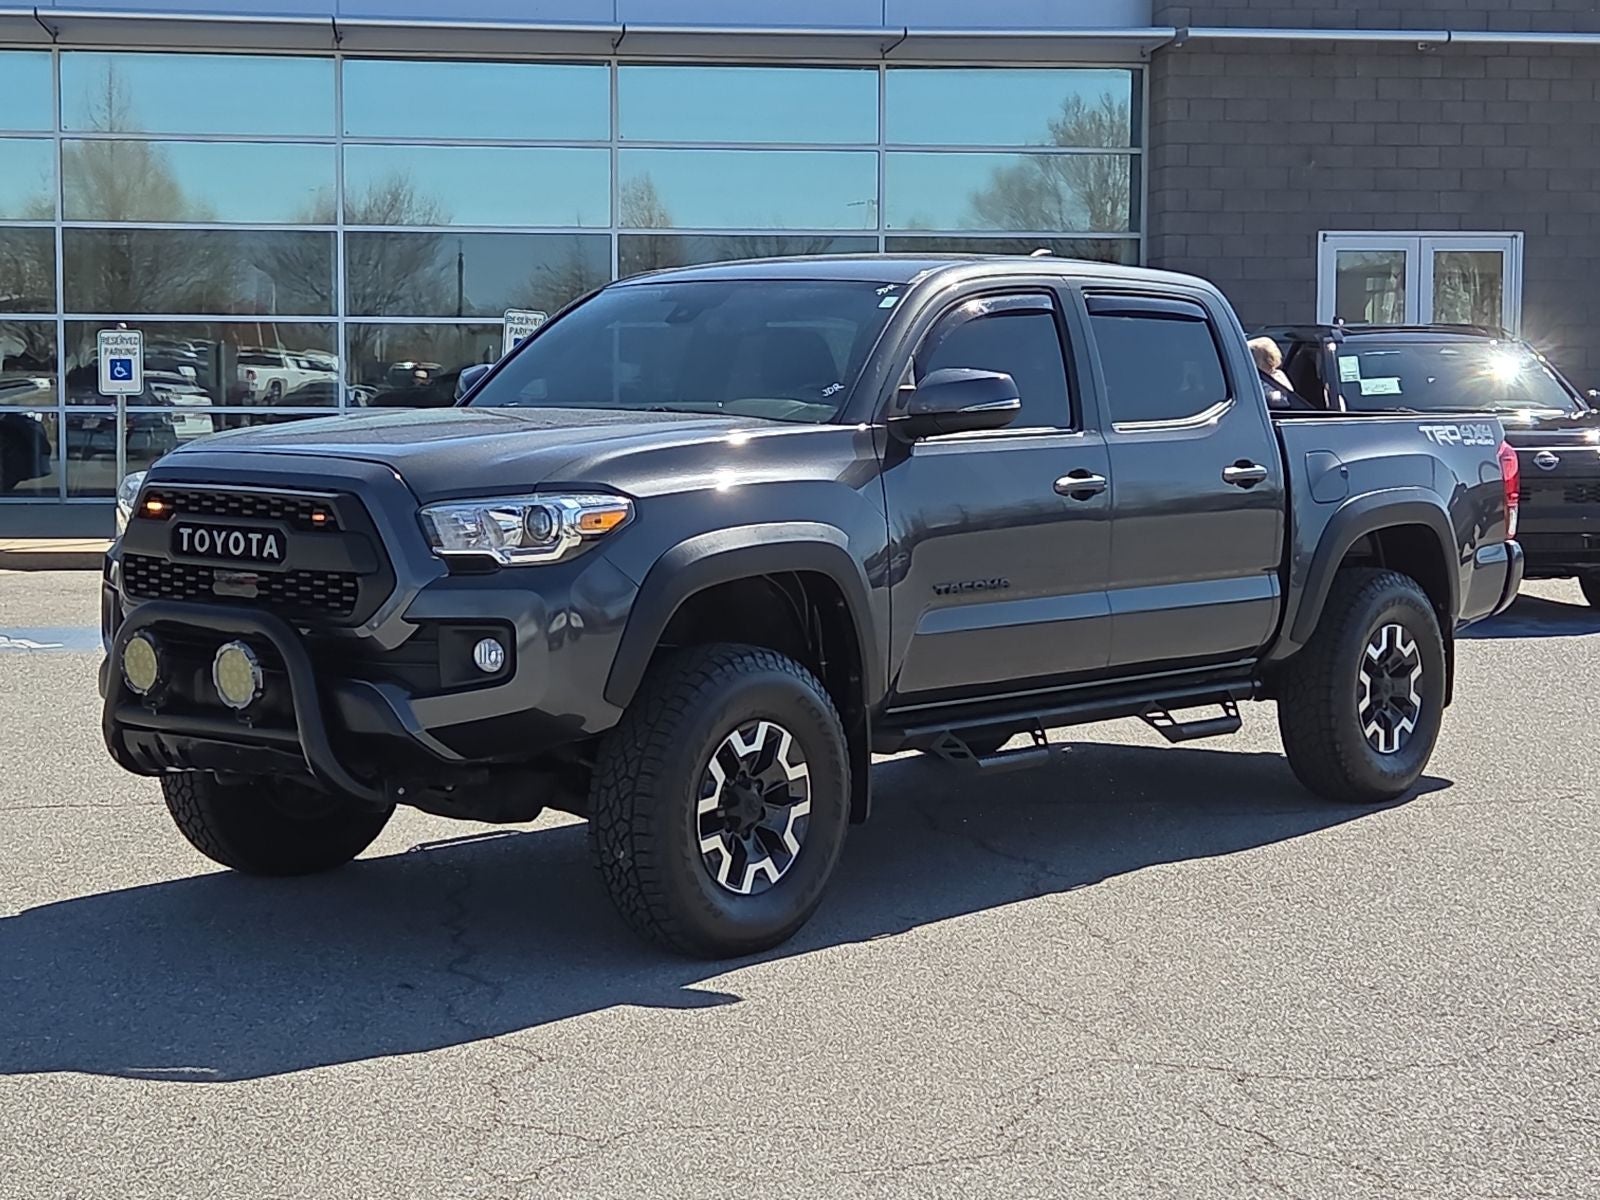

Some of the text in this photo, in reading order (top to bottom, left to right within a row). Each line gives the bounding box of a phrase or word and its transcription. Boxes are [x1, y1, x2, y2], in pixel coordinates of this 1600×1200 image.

[100, 336, 139, 345] RESERVED
[104, 347, 137, 356] PARKING
[822, 383, 845, 397] JDR
[1418, 425, 1462, 446] TRD
[178, 527, 280, 558] TOYOTA
[932, 577, 1010, 595] TACOMA
